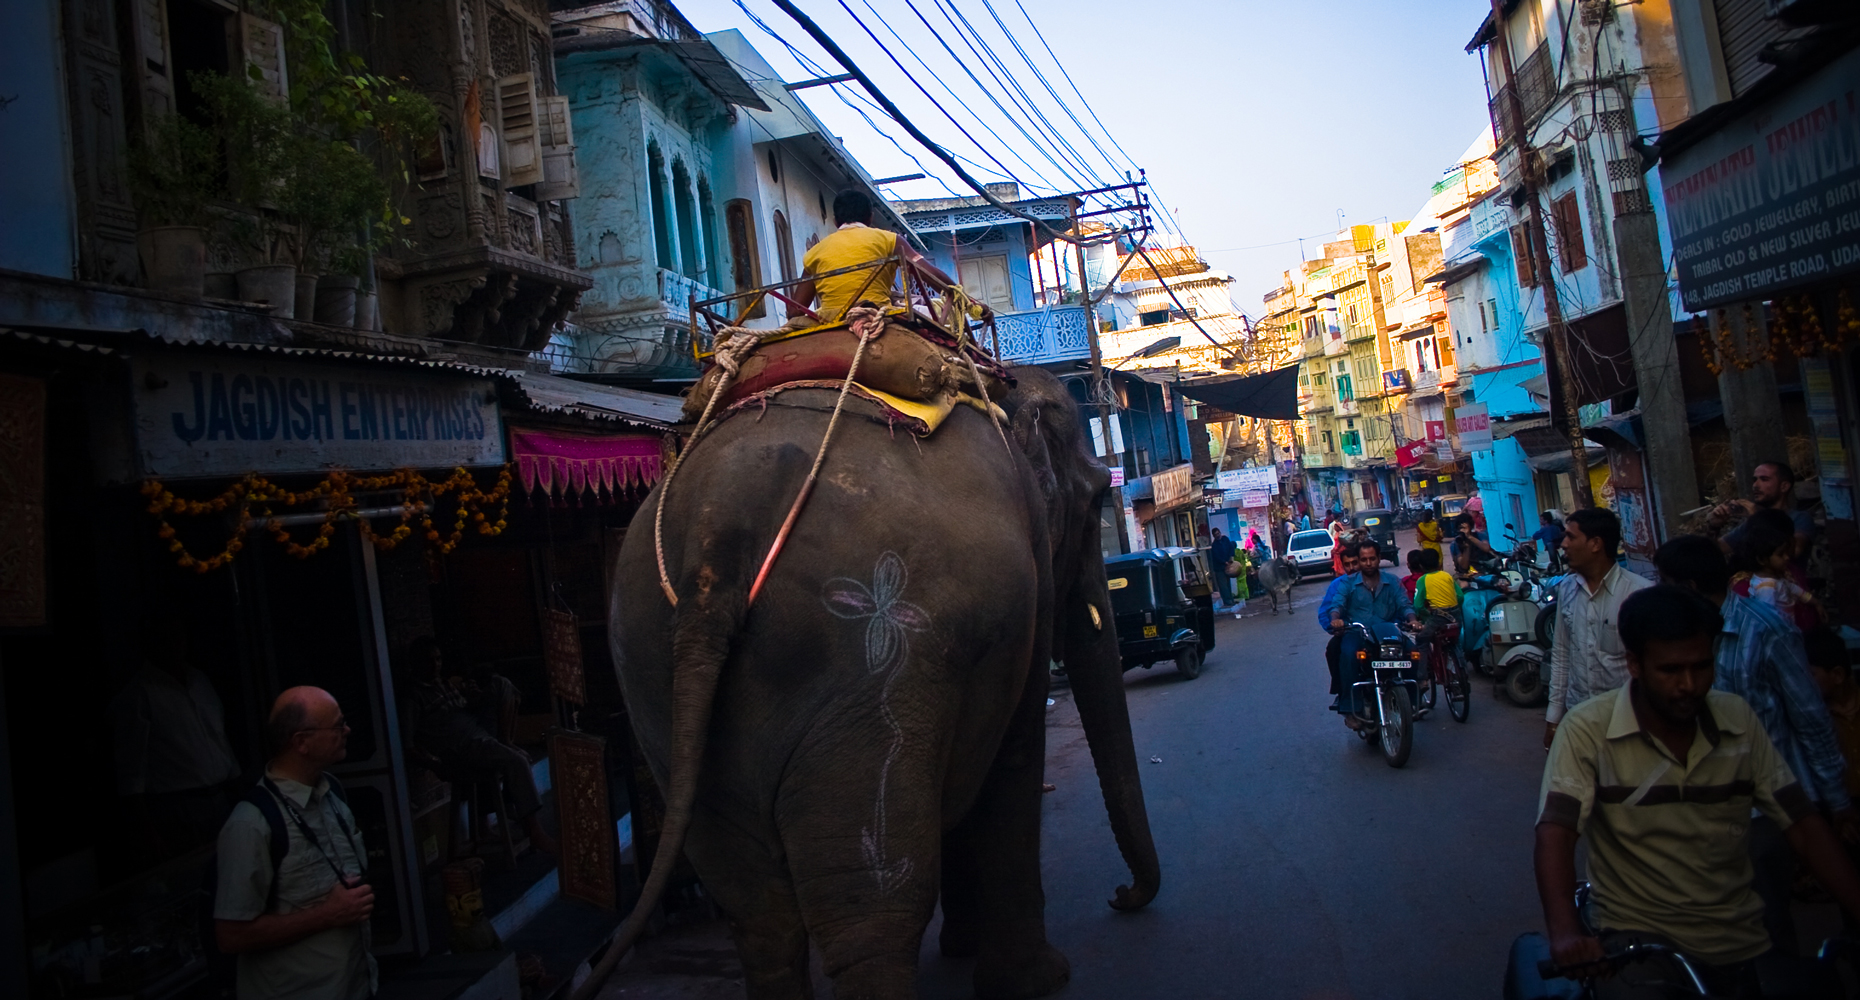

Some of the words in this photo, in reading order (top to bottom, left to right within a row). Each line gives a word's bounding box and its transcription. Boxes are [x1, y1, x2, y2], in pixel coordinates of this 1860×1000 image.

[1664, 144, 1764, 241] NEMINATH
[1676, 243, 1703, 262] DEALS
[1703, 239, 1714, 254] IN
[1721, 223, 1751, 245] GOLD
[1754, 196, 1823, 234] JEWELLERY,
[1691, 258, 1723, 279] TRIBAL
[1724, 250, 1746, 269] OLD
[1747, 246, 1759, 262] &
[1760, 237, 1787, 258] NEW
[1790, 224, 1832, 250] SILVER
[1683, 290, 1702, 307] 148,
[1702, 277, 1742, 302] JAGDISH
[1743, 264, 1788, 290] TEMPLE
[1789, 253, 1830, 276] ROAD,
[171, 371, 334, 443] JAGDISH
[339, 381, 486, 441] ENTERPRISES
